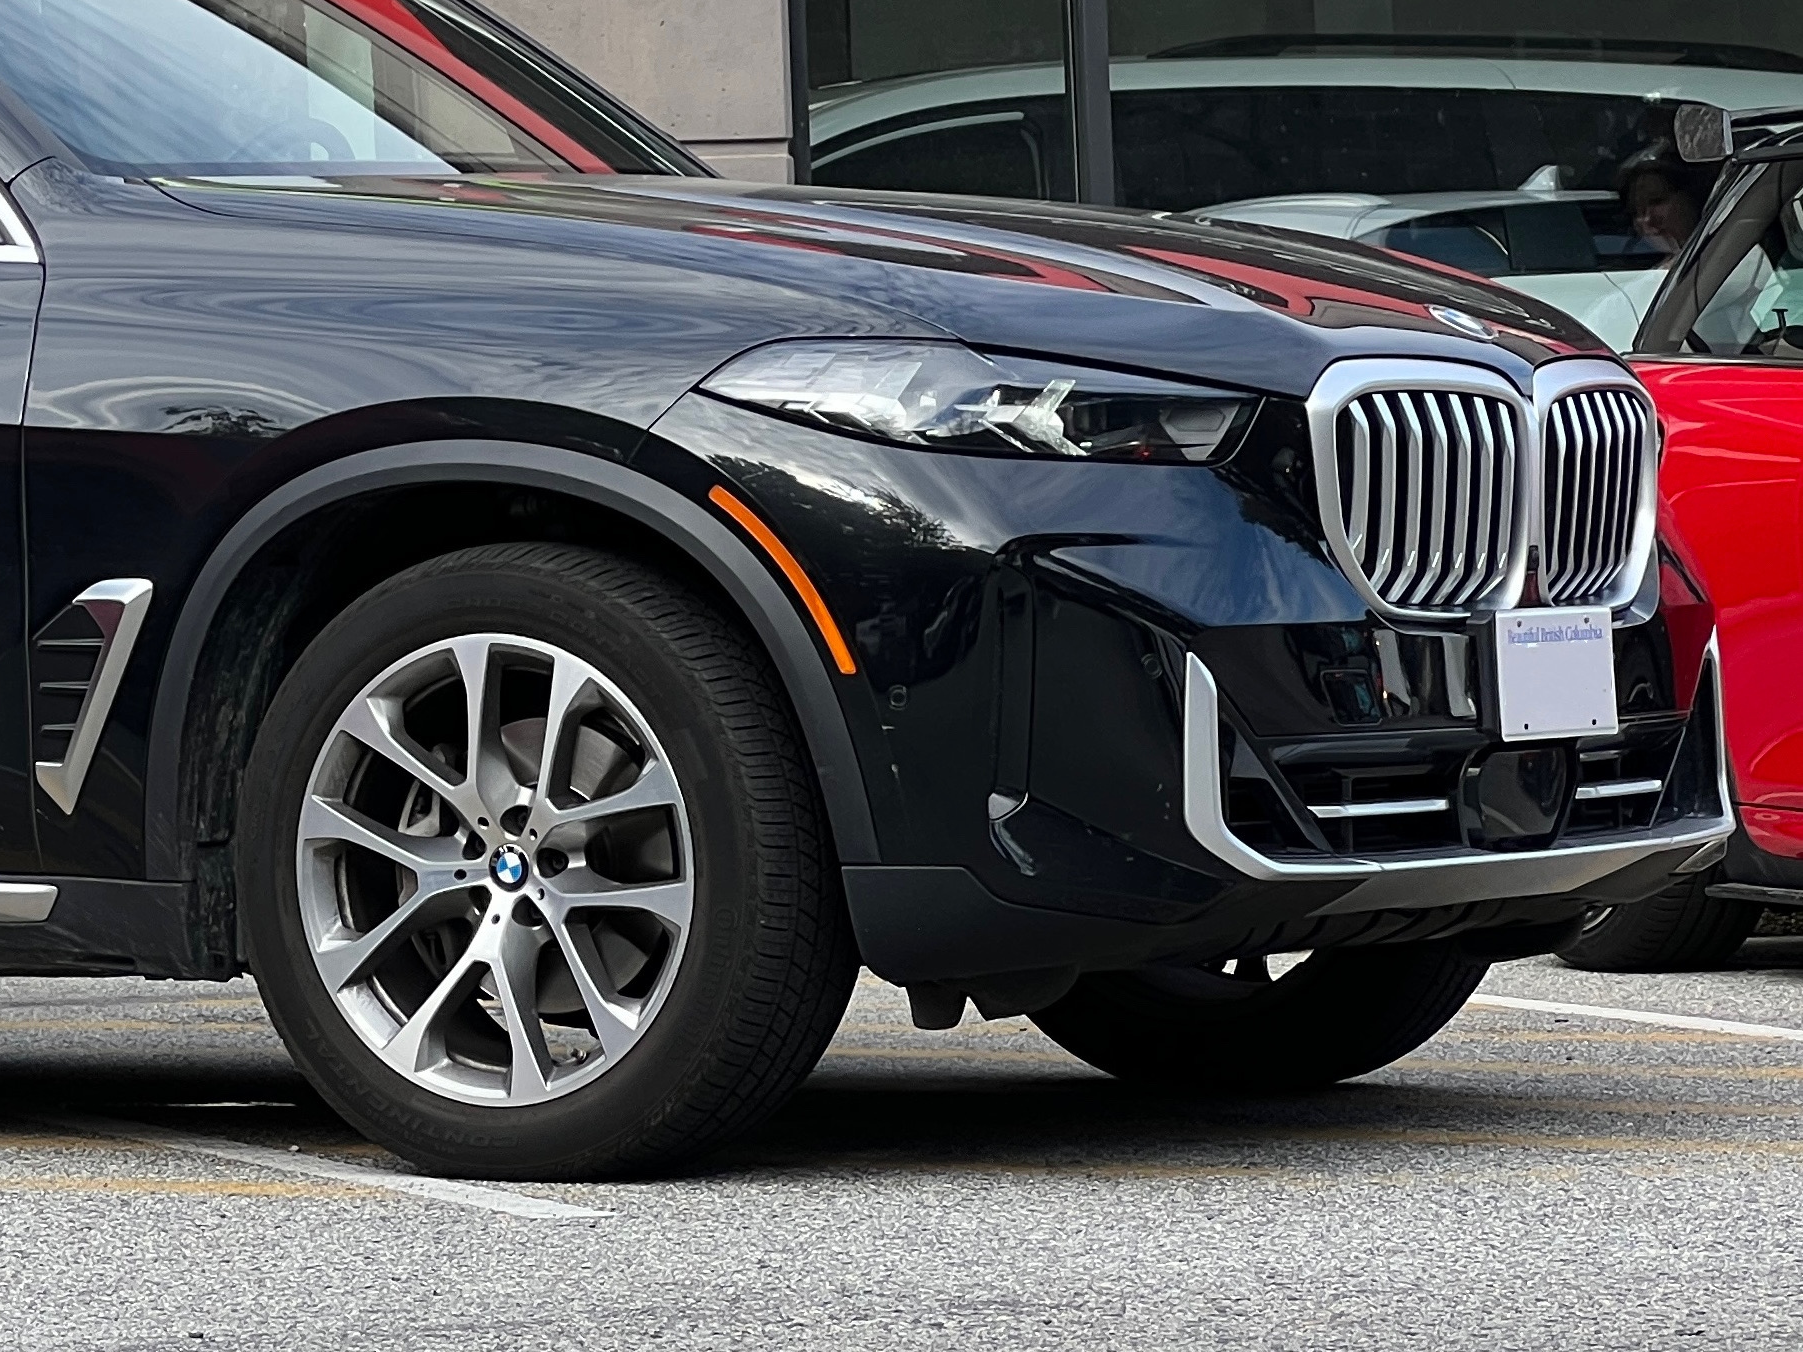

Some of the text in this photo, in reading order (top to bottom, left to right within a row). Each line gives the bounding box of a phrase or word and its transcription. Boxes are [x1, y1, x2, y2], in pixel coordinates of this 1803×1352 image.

[1507, 623, 1603, 645] Beautiful British Columbia
